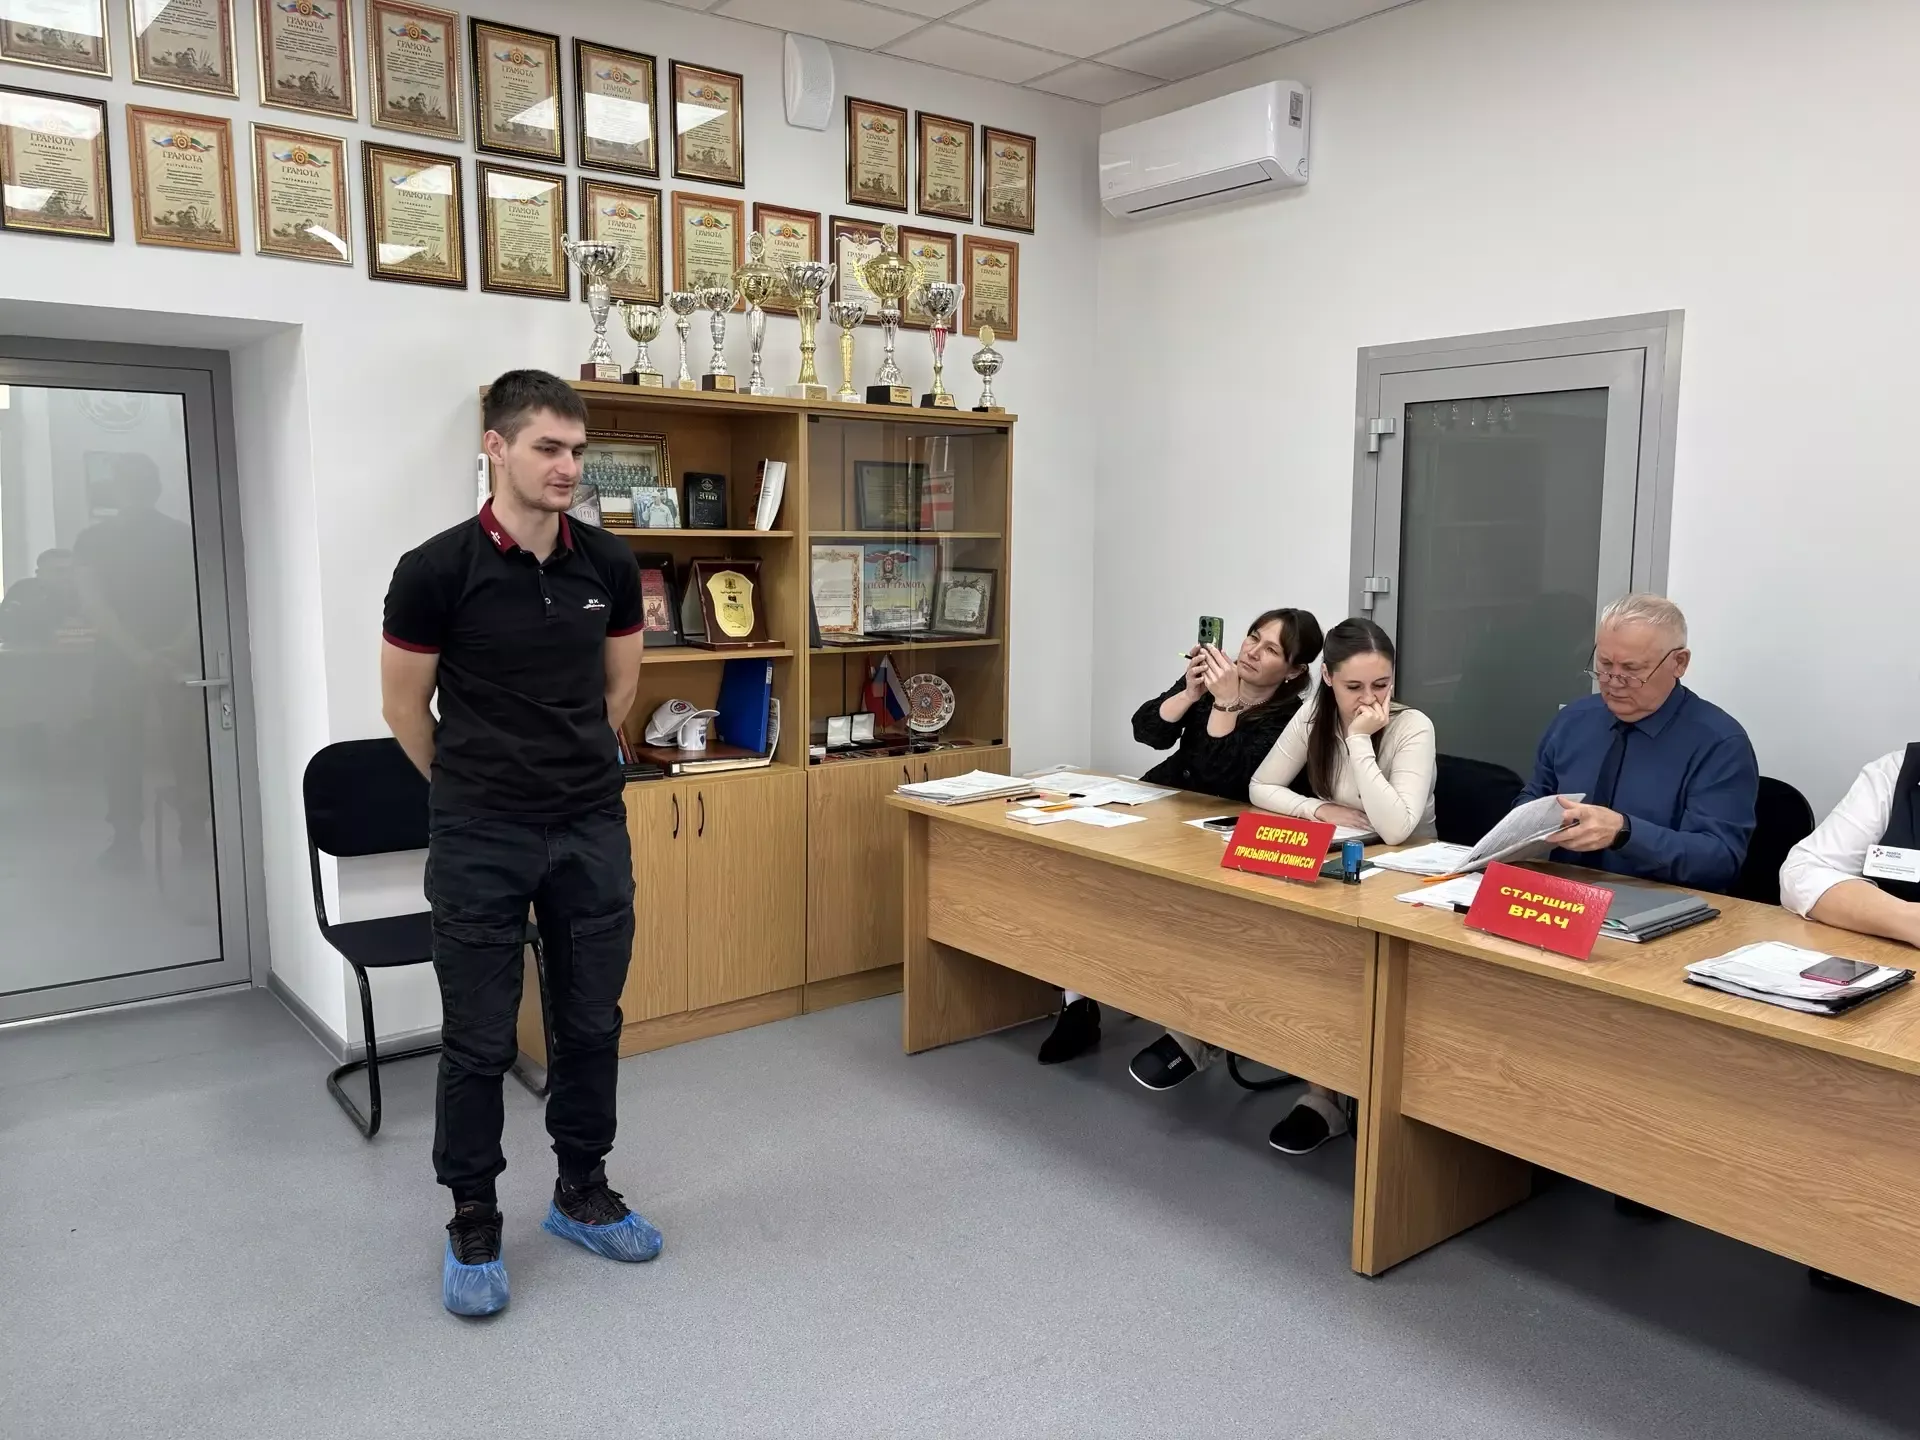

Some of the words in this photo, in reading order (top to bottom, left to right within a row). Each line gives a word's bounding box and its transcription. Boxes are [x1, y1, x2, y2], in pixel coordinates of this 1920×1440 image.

[286, 16, 324, 30] ГРАМОТА
[397, 40, 432, 53] ГРАМОТА
[502, 65, 534, 77] ГРАМОТА
[603, 83, 632, 95] ГРАМОТА
[30, 133, 75, 146] ГРАМОТА
[163, 151, 203, 163] ГРАМОТА
[282, 166, 320, 178] ГРАМОТА
[398, 189, 432, 201] ГРАМОТА
[509, 206, 540, 216] ГРАМОТА
[608, 220, 637, 230] ГРАМОТА
[696, 229, 722, 238] ГРАМОТА
[1256, 825, 1309, 847] СЕКРЕТАРЬ
[1234, 846, 1279, 862] ПРИЗЫВНОЙ
[1279, 853, 1316, 869] КОМИССИ
[1500, 886, 1585, 915] СТАРШИЙ
[1508, 904, 1570, 929] ВРАЧ
